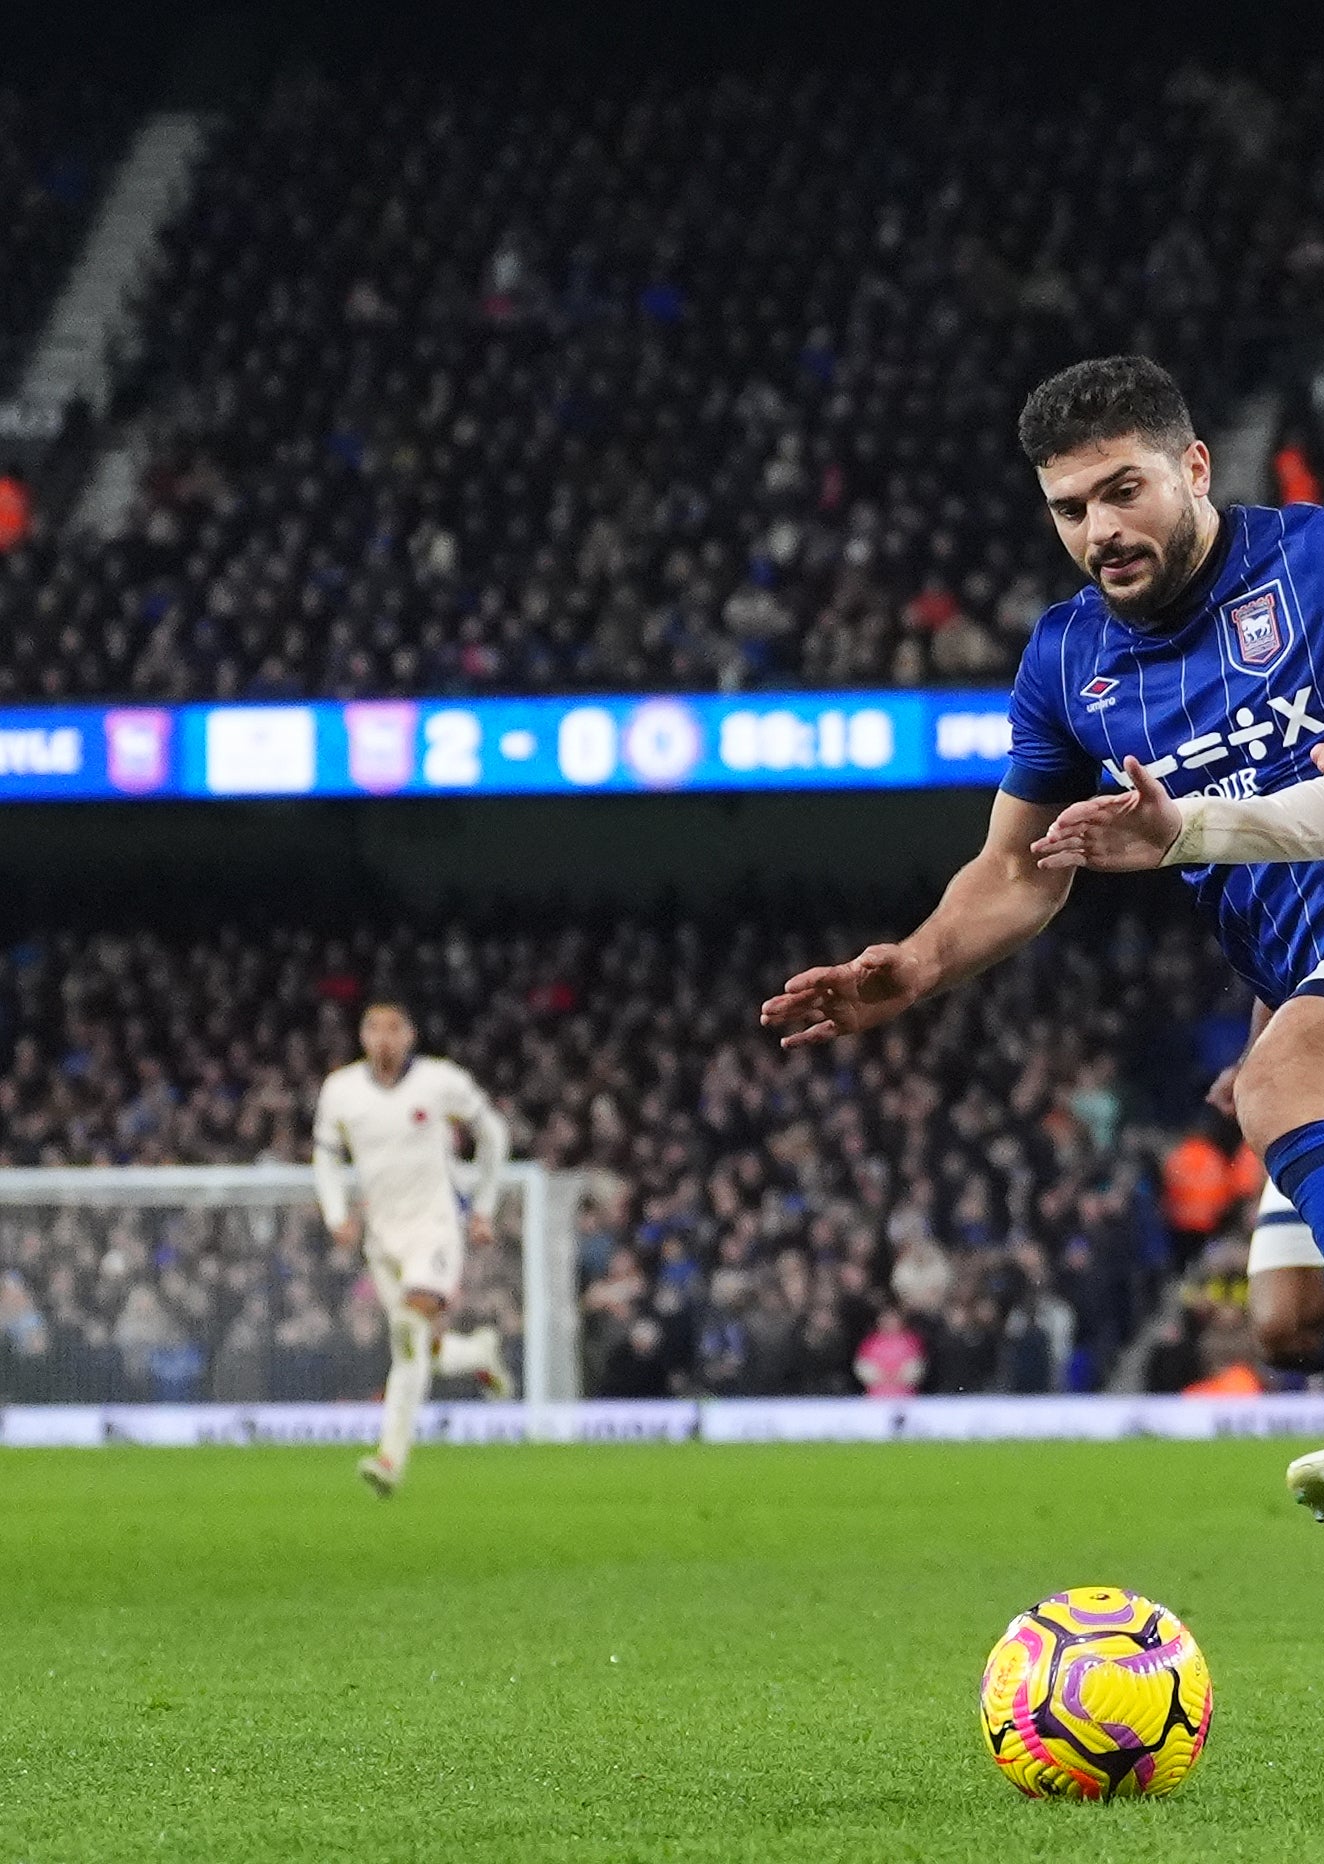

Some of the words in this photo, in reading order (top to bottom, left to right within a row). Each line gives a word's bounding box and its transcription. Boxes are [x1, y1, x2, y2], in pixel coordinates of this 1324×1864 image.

[1086, 697, 1116, 714] umbro
[424, 708, 481, 787] 2
[558, 707, 617, 786] 0
